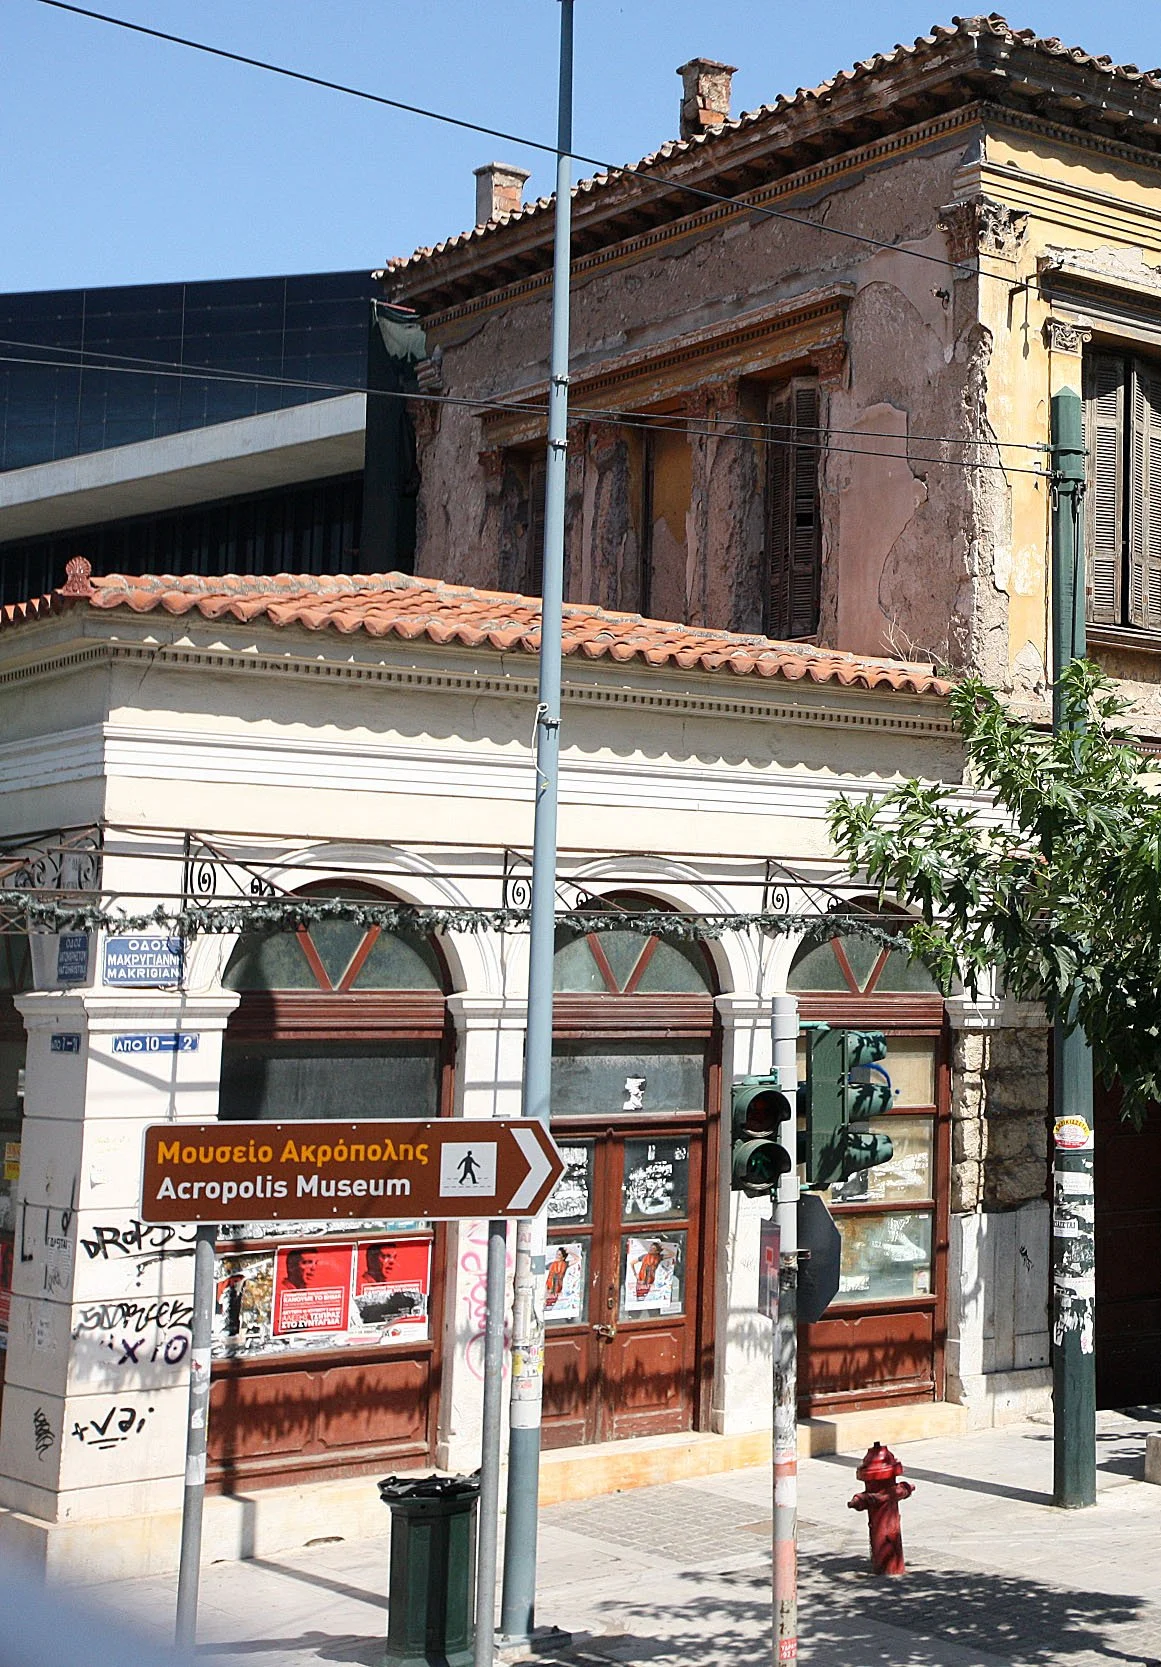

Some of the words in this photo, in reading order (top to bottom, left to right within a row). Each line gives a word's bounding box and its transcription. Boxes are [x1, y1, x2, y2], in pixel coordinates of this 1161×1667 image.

[128, 940, 169, 951] ΟΔΟΣ
[107, 967, 180, 979] MAKRIGIAN
[116, 1040, 143, 1051] ΑΠΟ
[145, 1036, 159, 1050] 10
[183, 1036, 192, 1050] 2
[157, 1140, 273, 1164] Μουσείο
[279, 1139, 429, 1166] Ακρόπολης
[156, 1176, 289, 1204] Acropolis
[296, 1175, 411, 1198] Museum
